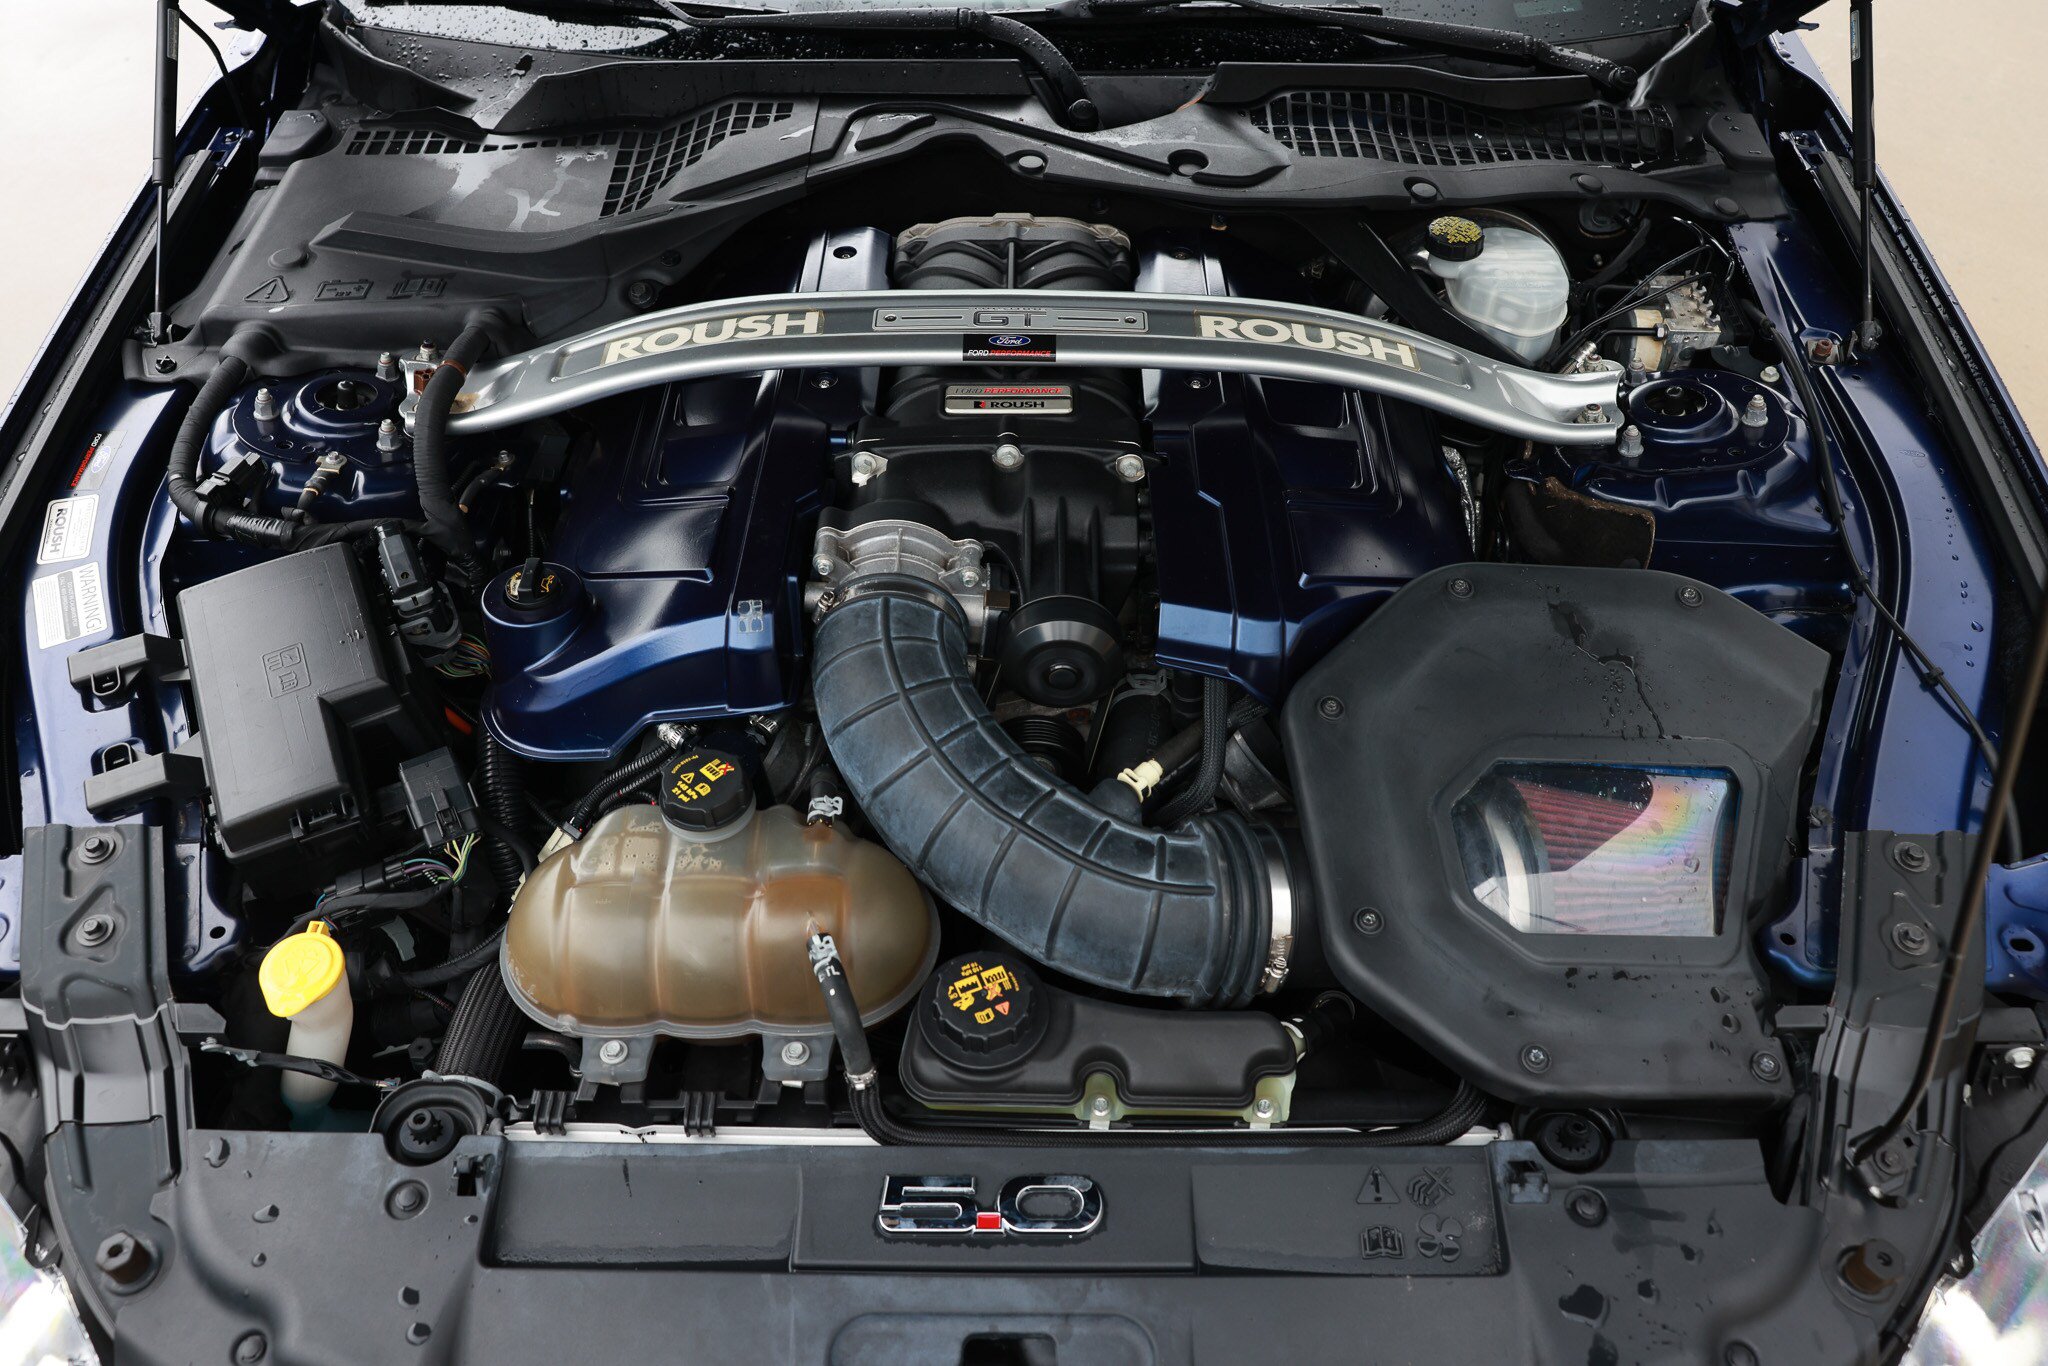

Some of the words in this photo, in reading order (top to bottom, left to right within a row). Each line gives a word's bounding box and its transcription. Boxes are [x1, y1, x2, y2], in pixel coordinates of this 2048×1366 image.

[604, 311, 820, 365] ROUSH
[973, 311, 1047, 327] GT
[996, 335, 1023, 345] Ford
[1199, 315, 1416, 368] ROUSH
[91, 433, 102, 447] FORD
[71, 447, 95, 487] PERFORMANCE
[49, 508, 68, 553] ROUSH
[79, 564, 103, 633] WARNING!
[879, 1175, 1104, 1234] 5.0
